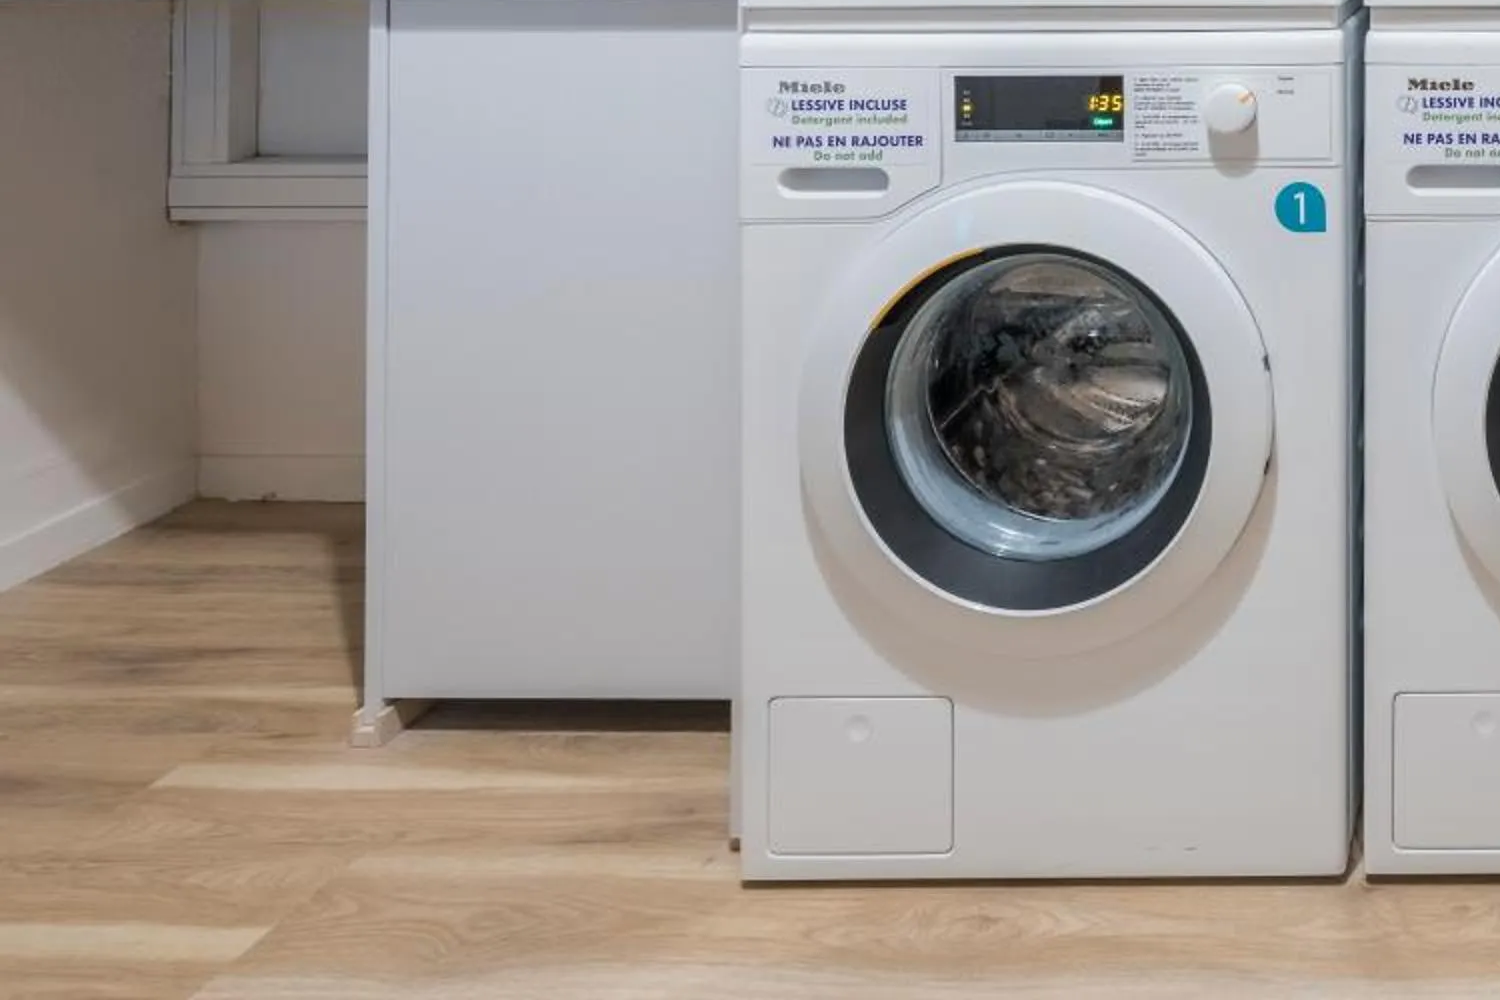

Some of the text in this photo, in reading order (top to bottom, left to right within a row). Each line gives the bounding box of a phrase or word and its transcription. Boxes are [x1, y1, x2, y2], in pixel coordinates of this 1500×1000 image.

[779, 81, 845, 93] Miele
[1408, 78, 1475, 91] Miele
[791, 99, 907, 111] LESSIVE INCLUSE
[1422, 97, 1475, 109] LESSIVE
[792, 114, 908, 127] Detergent included
[1423, 112, 1483, 124] Detergent
[773, 136, 923, 147] NE PAS EN RAJOUTER
[1403, 133, 1422, 145] NE
[1427, 133, 1453, 145] PAS
[1458, 133, 1477, 145] EN
[813, 150, 883, 161] Do not add
[1444, 147, 1461, 158] Do
[1466, 147, 1485, 158] not
[1293, 191, 1306, 225] 1
